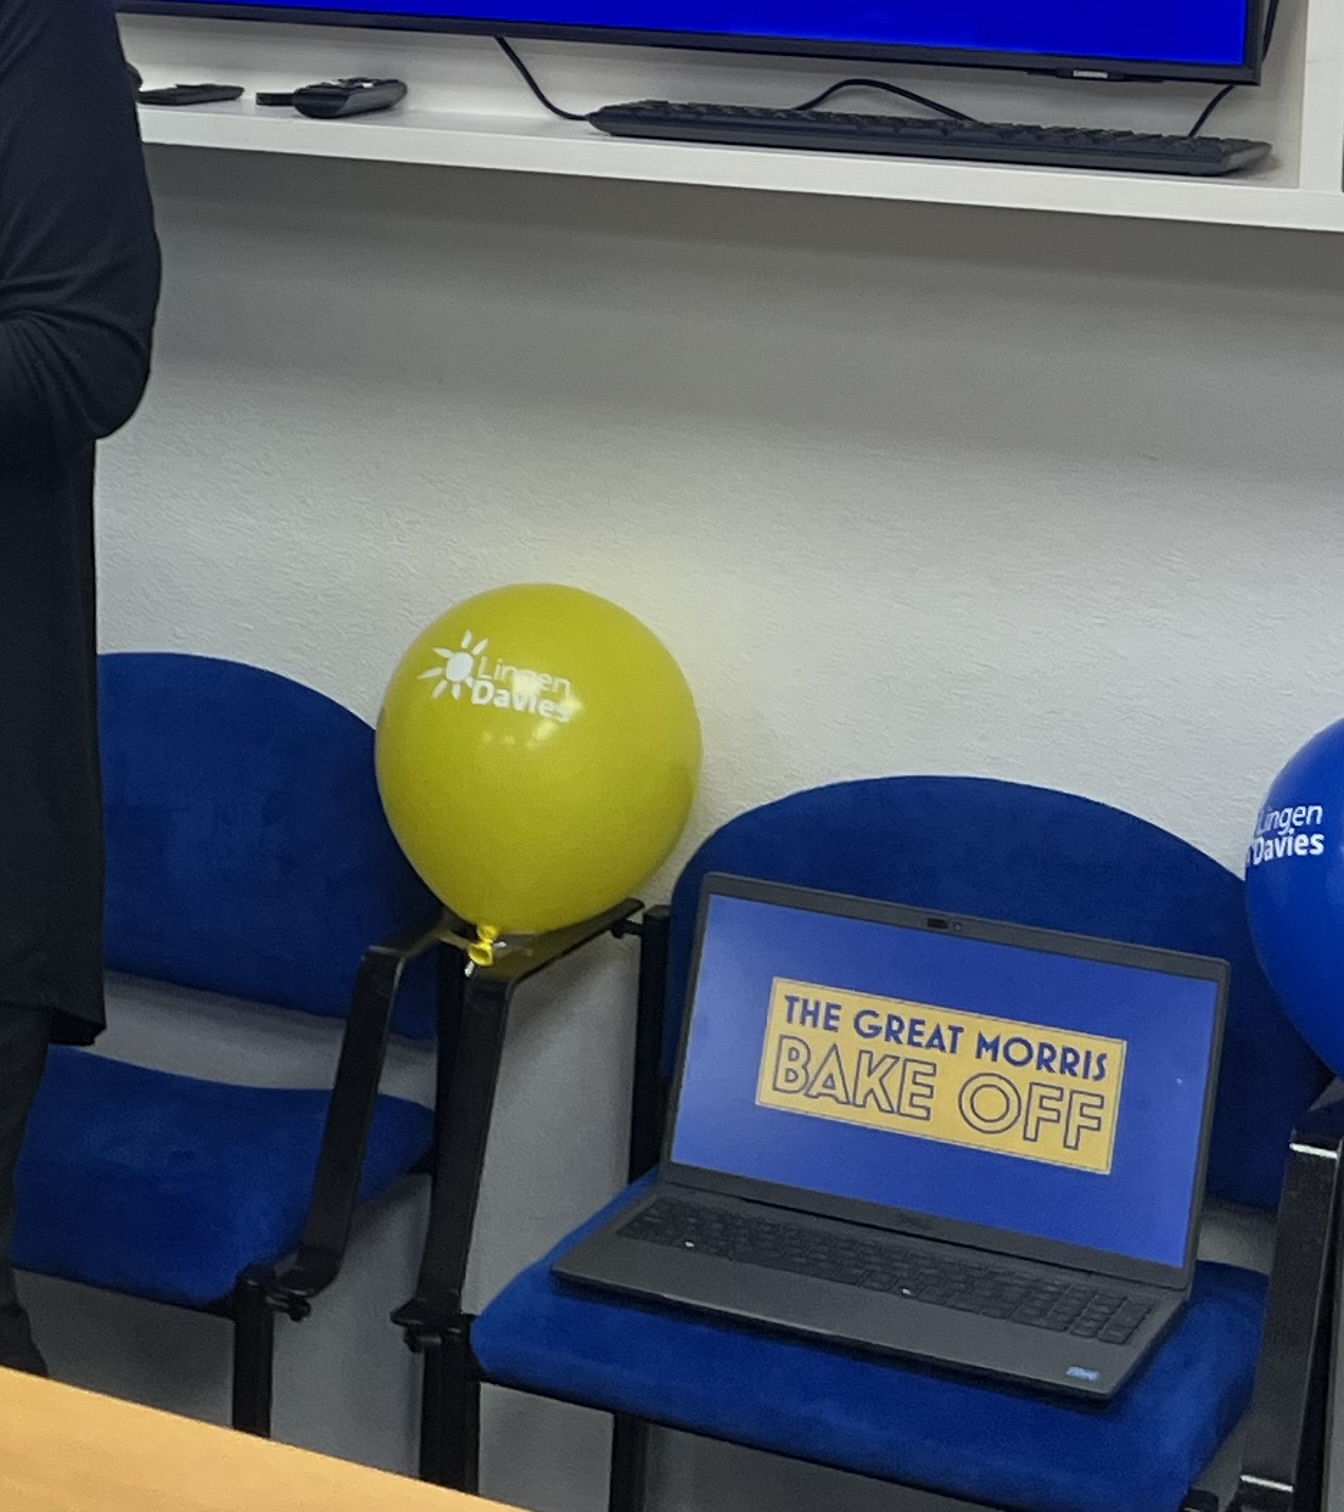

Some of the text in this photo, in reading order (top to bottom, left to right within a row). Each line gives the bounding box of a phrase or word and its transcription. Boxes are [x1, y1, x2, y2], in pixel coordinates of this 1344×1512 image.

[472, 680, 570, 722] Davies
[1253, 828, 1324, 865] Davies
[785, 995, 1107, 1081] THE GREAT MORRIS
[773, 1035, 1104, 1150] BAKE OFF
